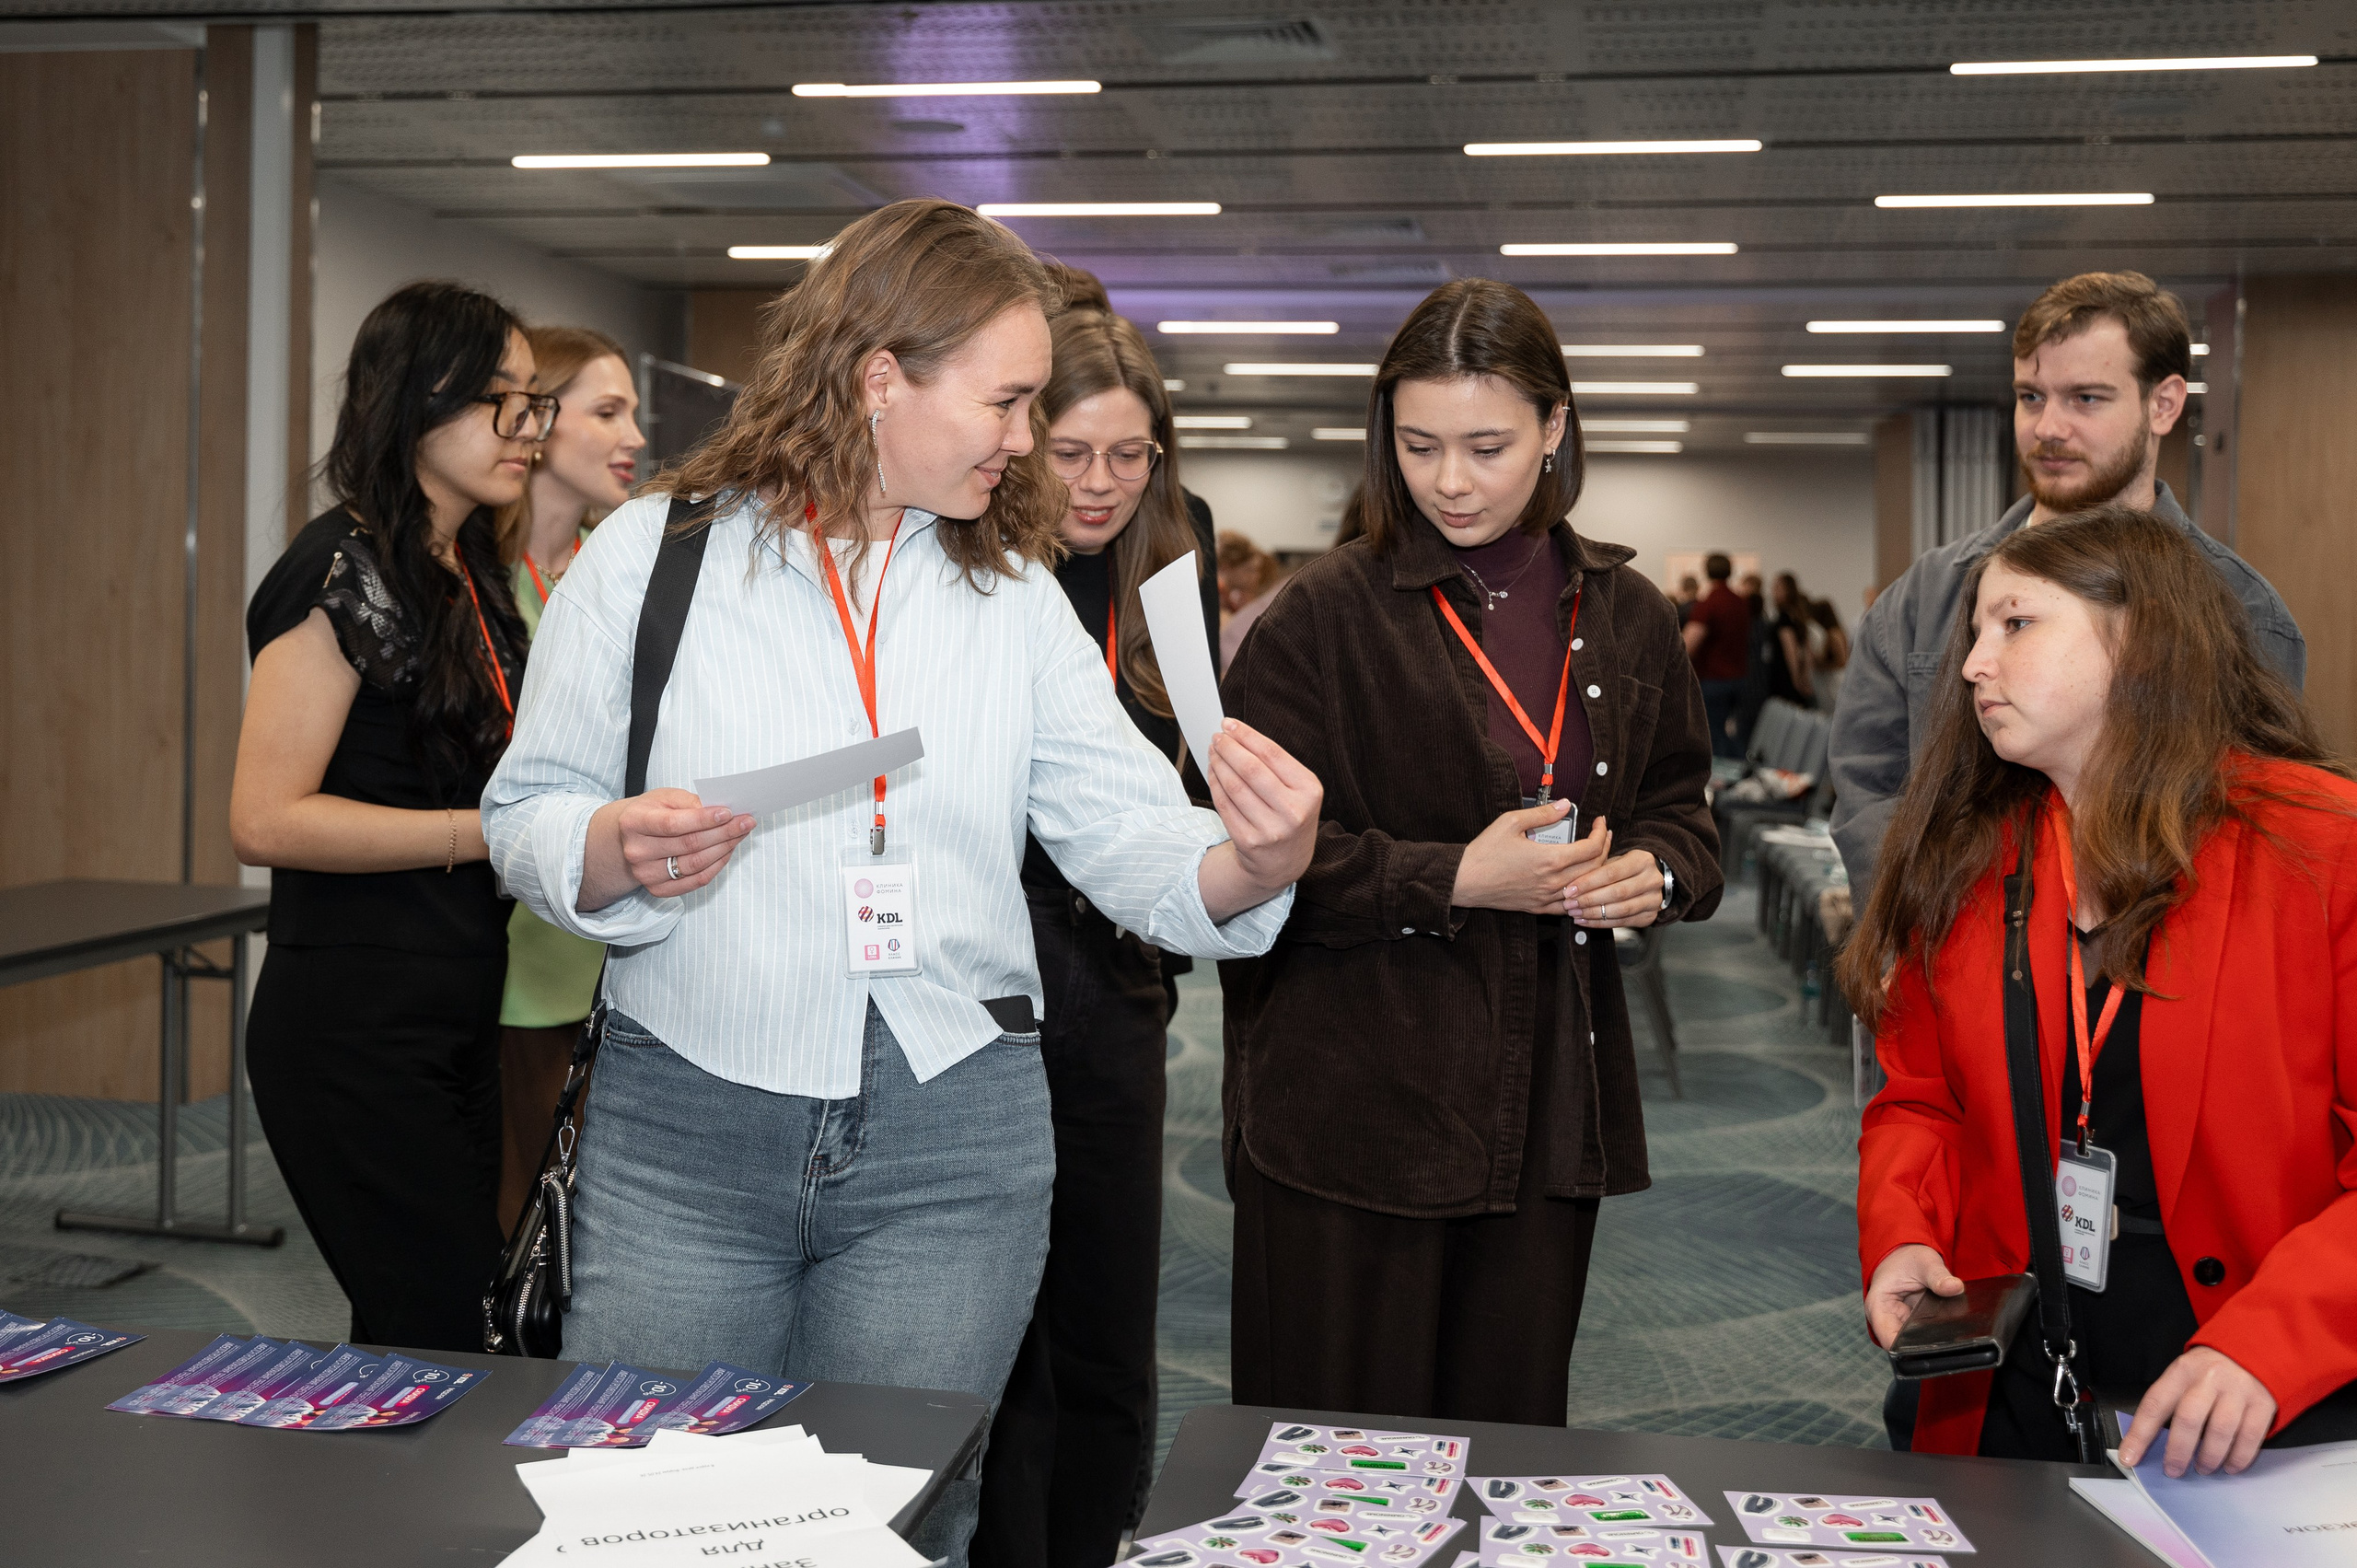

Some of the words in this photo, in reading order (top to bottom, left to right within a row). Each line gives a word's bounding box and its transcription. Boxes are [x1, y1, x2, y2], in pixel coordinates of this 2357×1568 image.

[877, 912, 902, 923] KDL
[2075, 1216, 2095, 1232] KDL
[581, 1507, 850, 1546] организаторов
[701, 1539, 764, 1555] для
